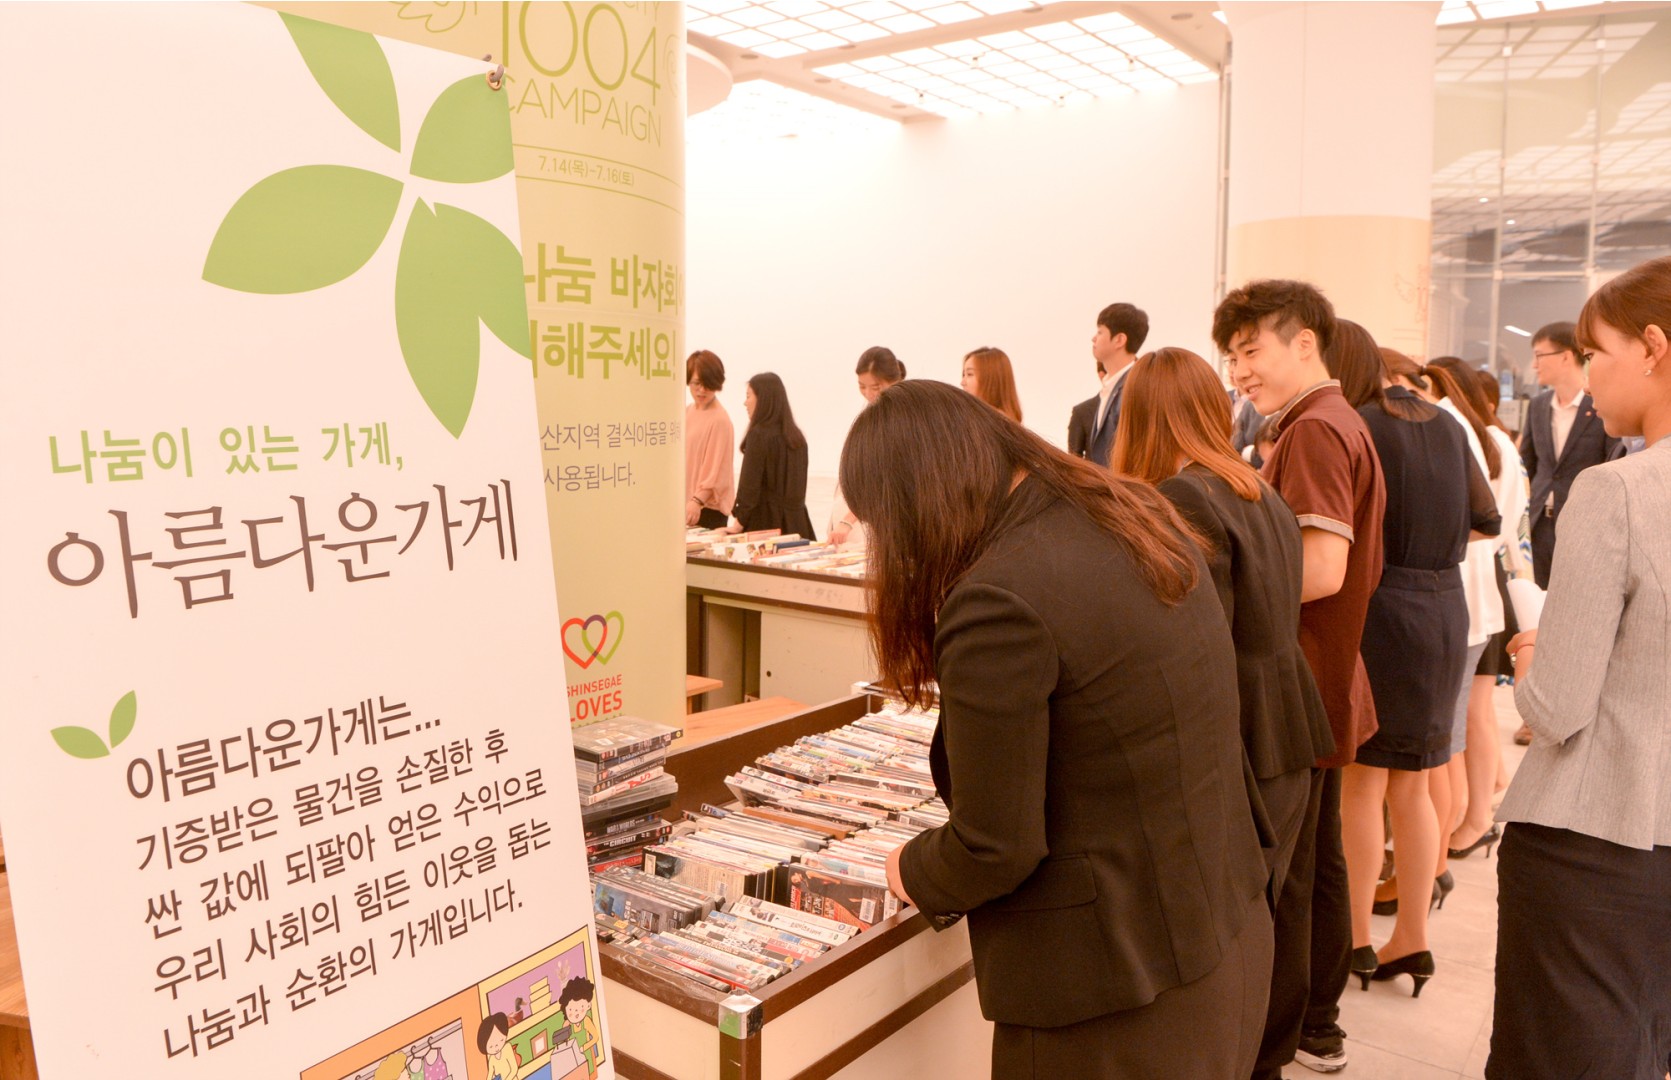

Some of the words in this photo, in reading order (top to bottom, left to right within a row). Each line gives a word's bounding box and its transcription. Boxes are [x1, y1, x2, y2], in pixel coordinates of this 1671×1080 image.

[530, 319, 676, 381] 해주세요!
[48, 427, 194, 486] 나눔이
[219, 425, 301, 476] 있는
[321, 421, 405, 472] 가게,
[544, 461, 636, 493] 사용됩니다.
[606, 421, 667, 448] 결식아동을
[46, 478, 518, 620] 아름다운가게
[126, 695, 442, 804] 아름다운가게는...
[136, 797, 279, 872] 기증받은
[292, 766, 384, 828] 물건을
[396, 737, 474, 795] 손질한
[485, 728, 509, 765] 후
[144, 888, 183, 942] 싼
[200, 860, 270, 923] 값에
[286, 824, 376, 888] 되팔아
[387, 803, 442, 854] 얻은
[453, 767, 548, 828] 수익으로
[154, 937, 227, 1003] 우리
[244, 894, 341, 964] 사회의
[354, 869, 411, 924] 힘든
[422, 836, 498, 890] 이웃을
[507, 817, 552, 862] 돕는
[162, 984, 271, 1061] 나눔과
[285, 937, 378, 1013] 순환의
[390, 878, 523, 961] 가게입니다.
